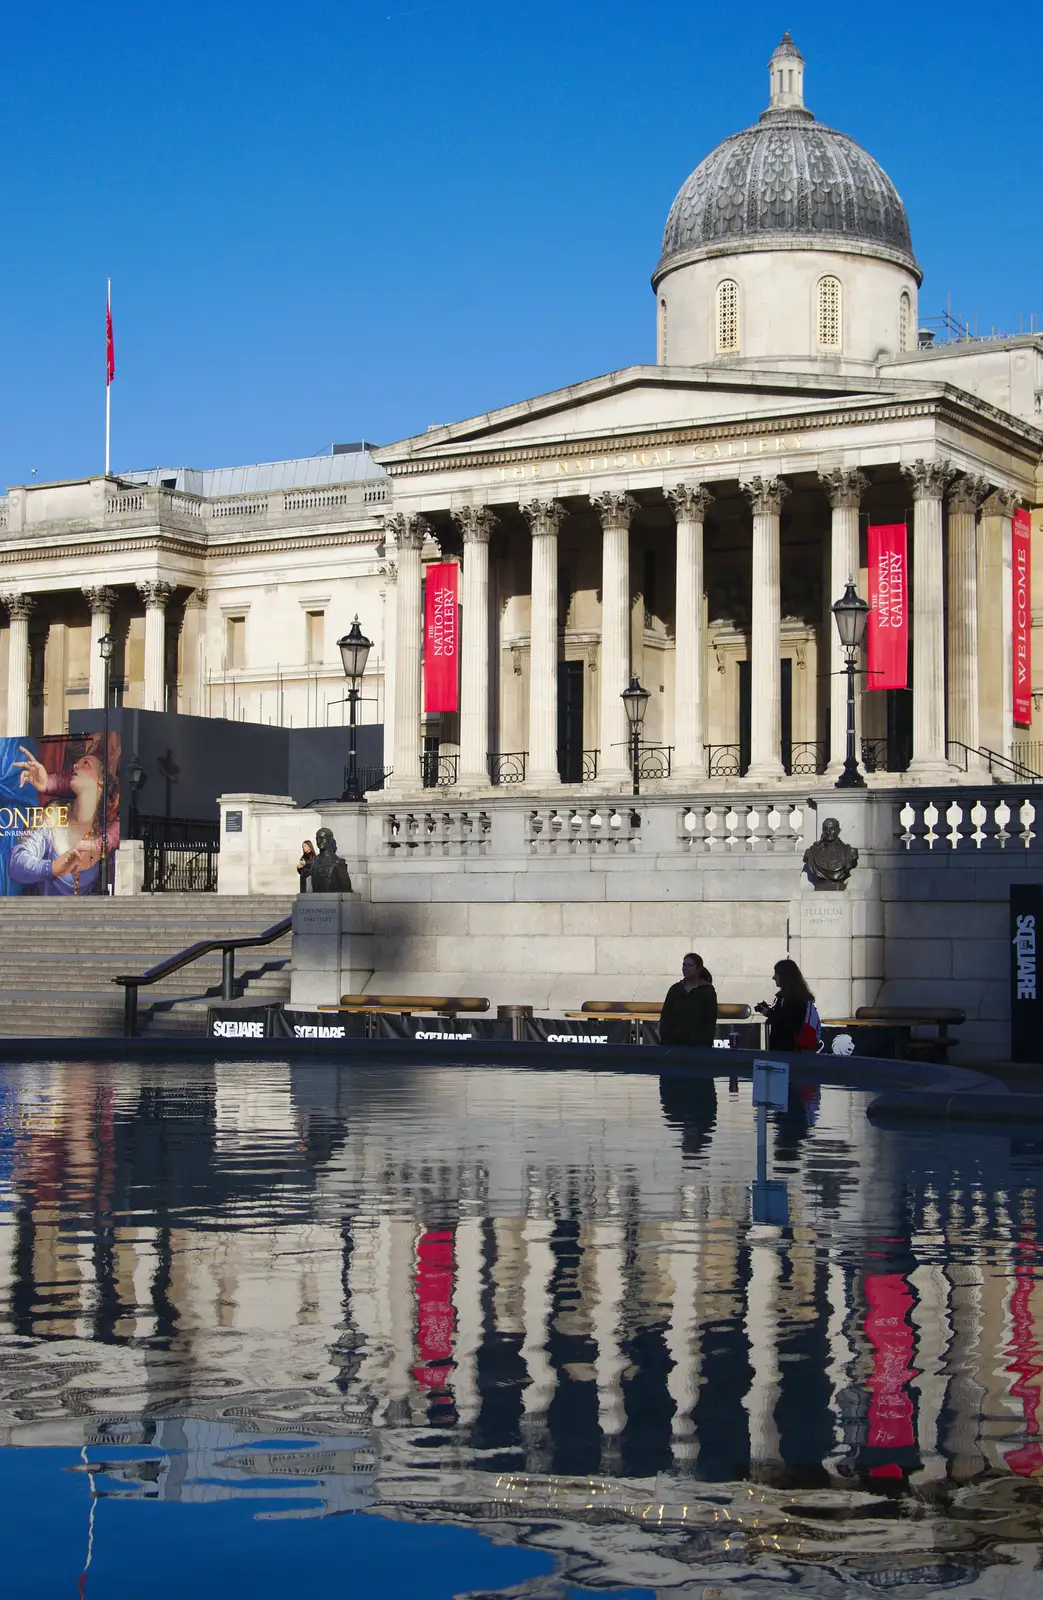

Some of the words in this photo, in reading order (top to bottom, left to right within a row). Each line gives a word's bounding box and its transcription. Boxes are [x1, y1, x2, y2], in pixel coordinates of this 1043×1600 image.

[497, 464, 541, 481] THE
[555, 449, 676, 474] NATIONAL
[693, 435, 805, 460] GALLERY
[434, 587, 444, 656] NATIONAL
[444, 588, 454, 656] GALLERY
[878, 551, 889, 628] NATIONAL
[890, 552, 903, 628] GALLERY
[1017, 548, 1026, 684] WELCOME
[0, 806, 69, 829] ONESE
[806, 907, 843, 916] JELLICOE
[1012, 914, 1037, 1000] SQUARE
[213, 1021, 264, 1038] SQUARE
